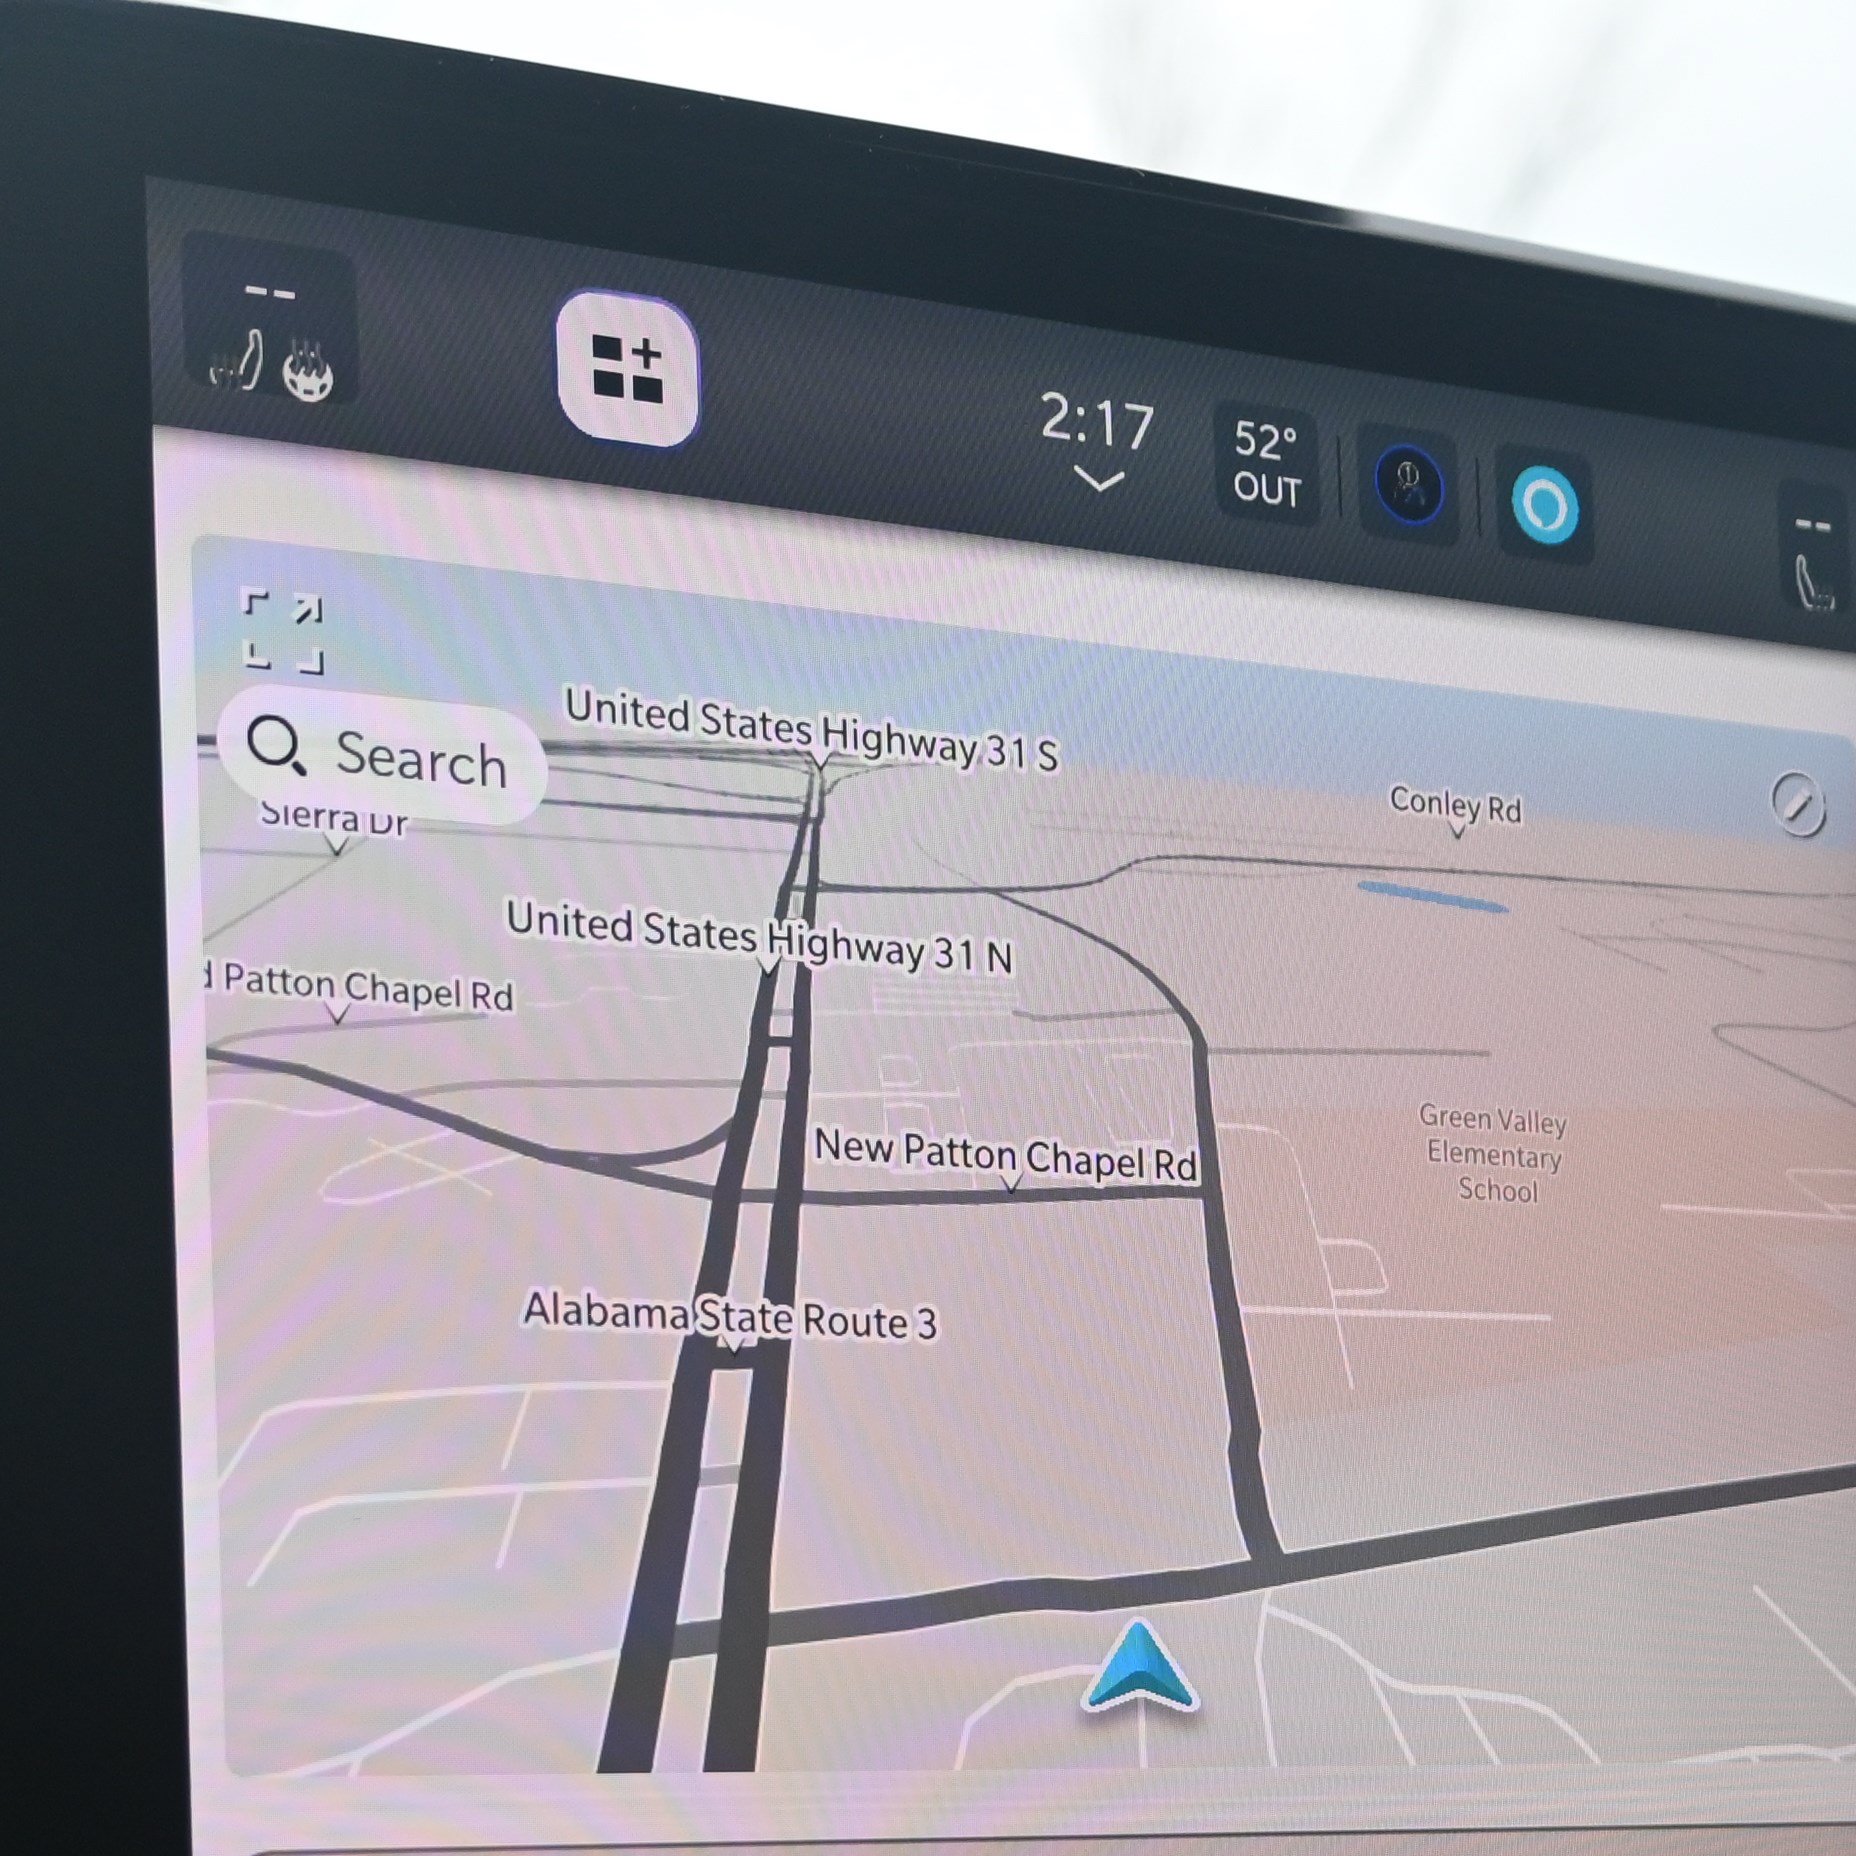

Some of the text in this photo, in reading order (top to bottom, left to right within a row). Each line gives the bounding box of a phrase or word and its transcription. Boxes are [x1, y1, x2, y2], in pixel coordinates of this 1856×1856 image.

[1039, 390, 1155, 452] 2:17
[1235, 420, 1298, 462] 52°
[1234, 470, 1302, 509] OUT
[566, 688, 1060, 773] United States Highway 31 S
[337, 729, 508, 789] Search
[261, 800, 359, 832] Sierra
[1391, 785, 1523, 826] Conley Rd
[507, 899, 1013, 974] United States Highway 31 N
[225, 962, 335, 998] Patton
[344, 972, 461, 1011] Chapel
[472, 981, 513, 1011] Rd
[1419, 1102, 1568, 1140] Green Valley
[816, 1128, 1197, 1183] New Patton Chapel Rd
[1428, 1139, 1562, 1174] Elementary
[1459, 1176, 1539, 1203] School
[524, 1291, 938, 1340] Alabama State Route 3
